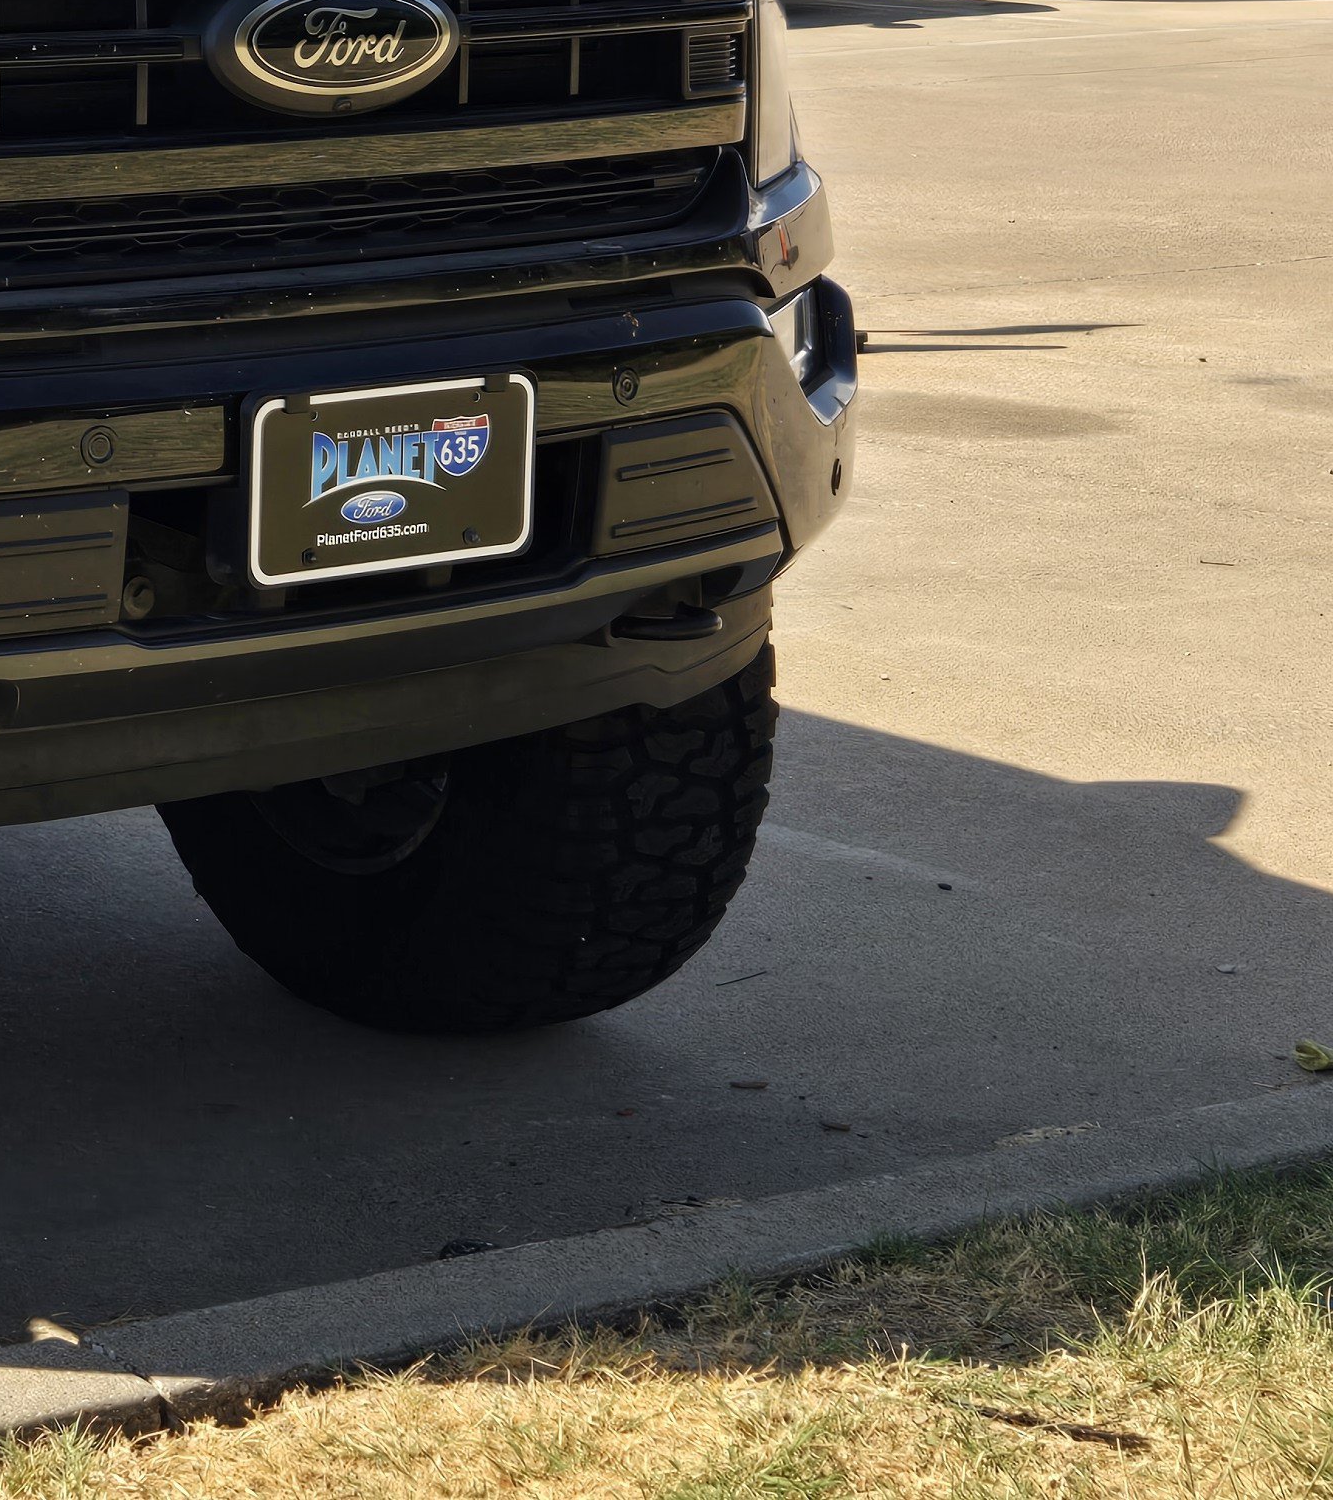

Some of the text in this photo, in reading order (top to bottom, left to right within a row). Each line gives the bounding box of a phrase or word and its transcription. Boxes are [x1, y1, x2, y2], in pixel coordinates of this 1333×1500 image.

[293, 7, 407, 69] Ford
[311, 430, 439, 502] PLANET
[440, 435, 480, 467] 635
[352, 495, 393, 520] Ford
[316, 522, 428, 547] PlanetFord635.com
